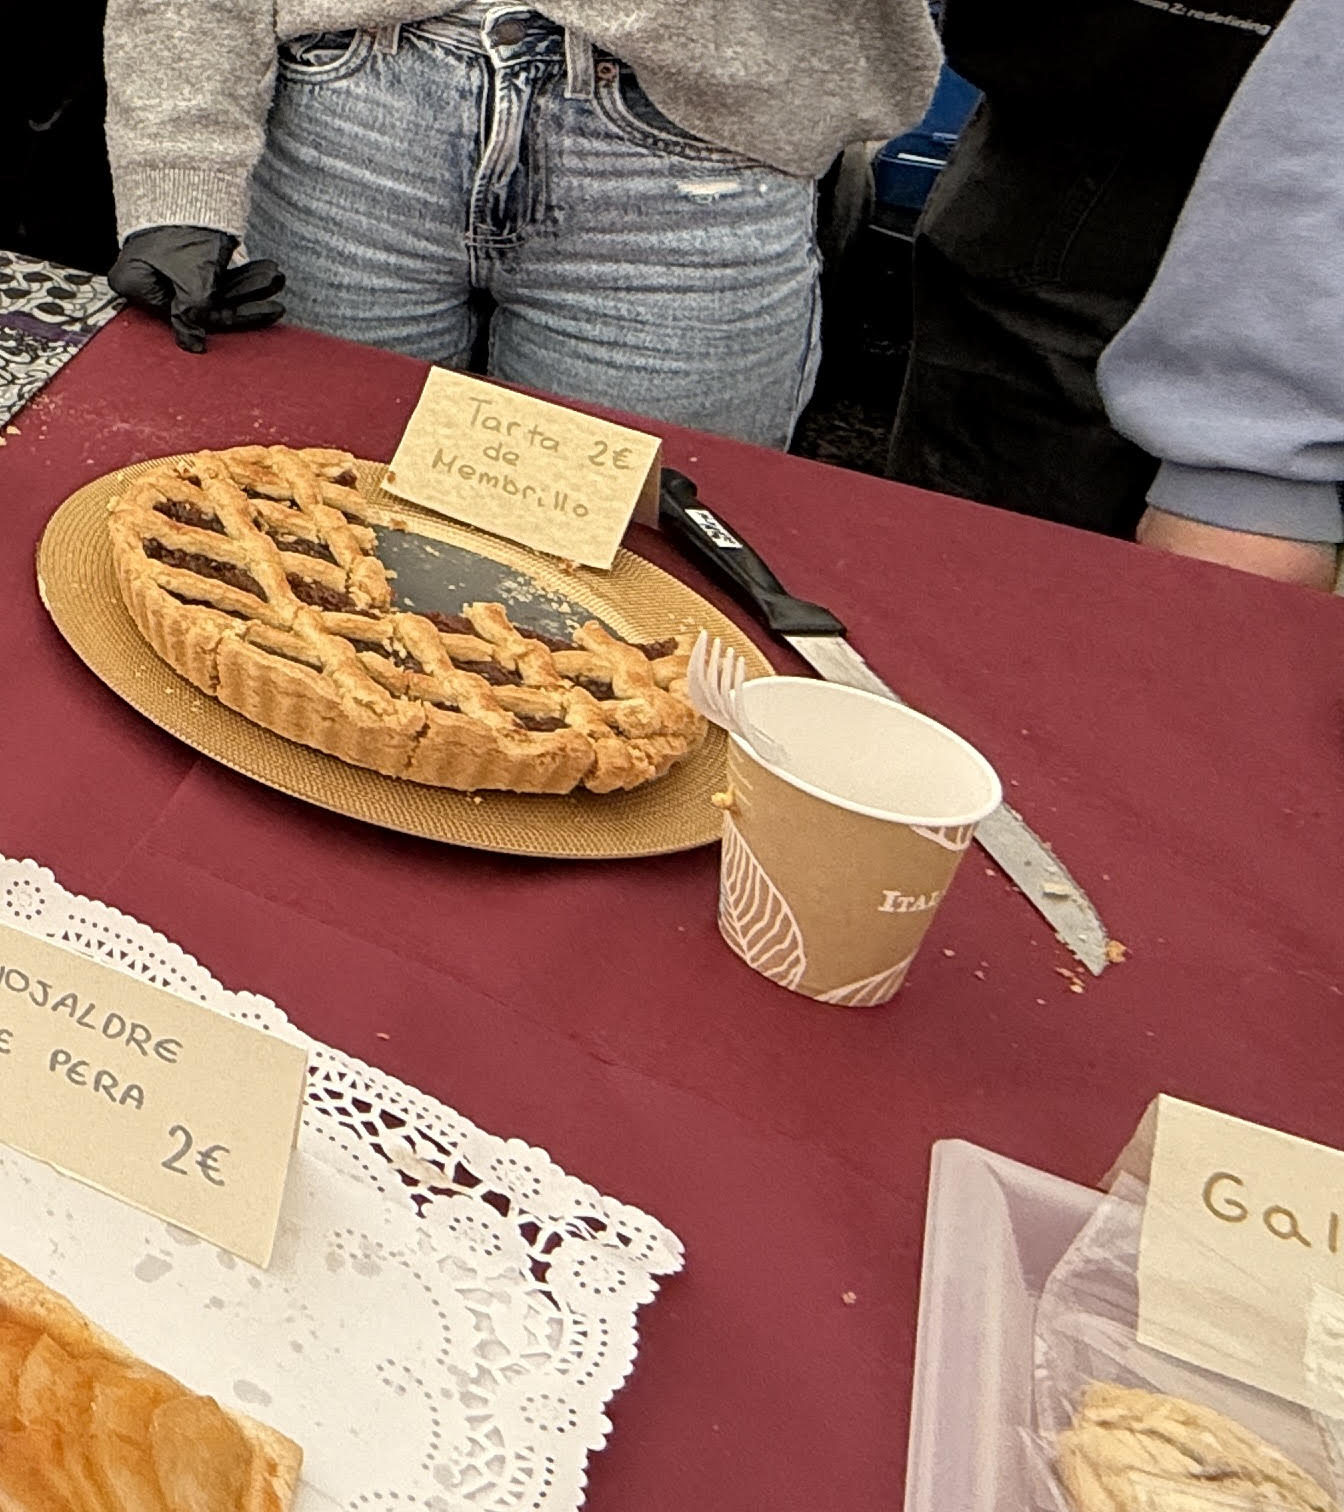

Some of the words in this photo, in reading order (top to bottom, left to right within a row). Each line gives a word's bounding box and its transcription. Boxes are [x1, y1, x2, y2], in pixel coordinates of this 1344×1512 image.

[468, 396, 560, 453] Tarta
[587, 439, 633, 470] 2€
[482, 441, 520, 468] de
[430, 447, 589, 519] Membrillo
[48, 1047, 146, 1111] PERA
[161, 1123, 231, 1187] 2€
